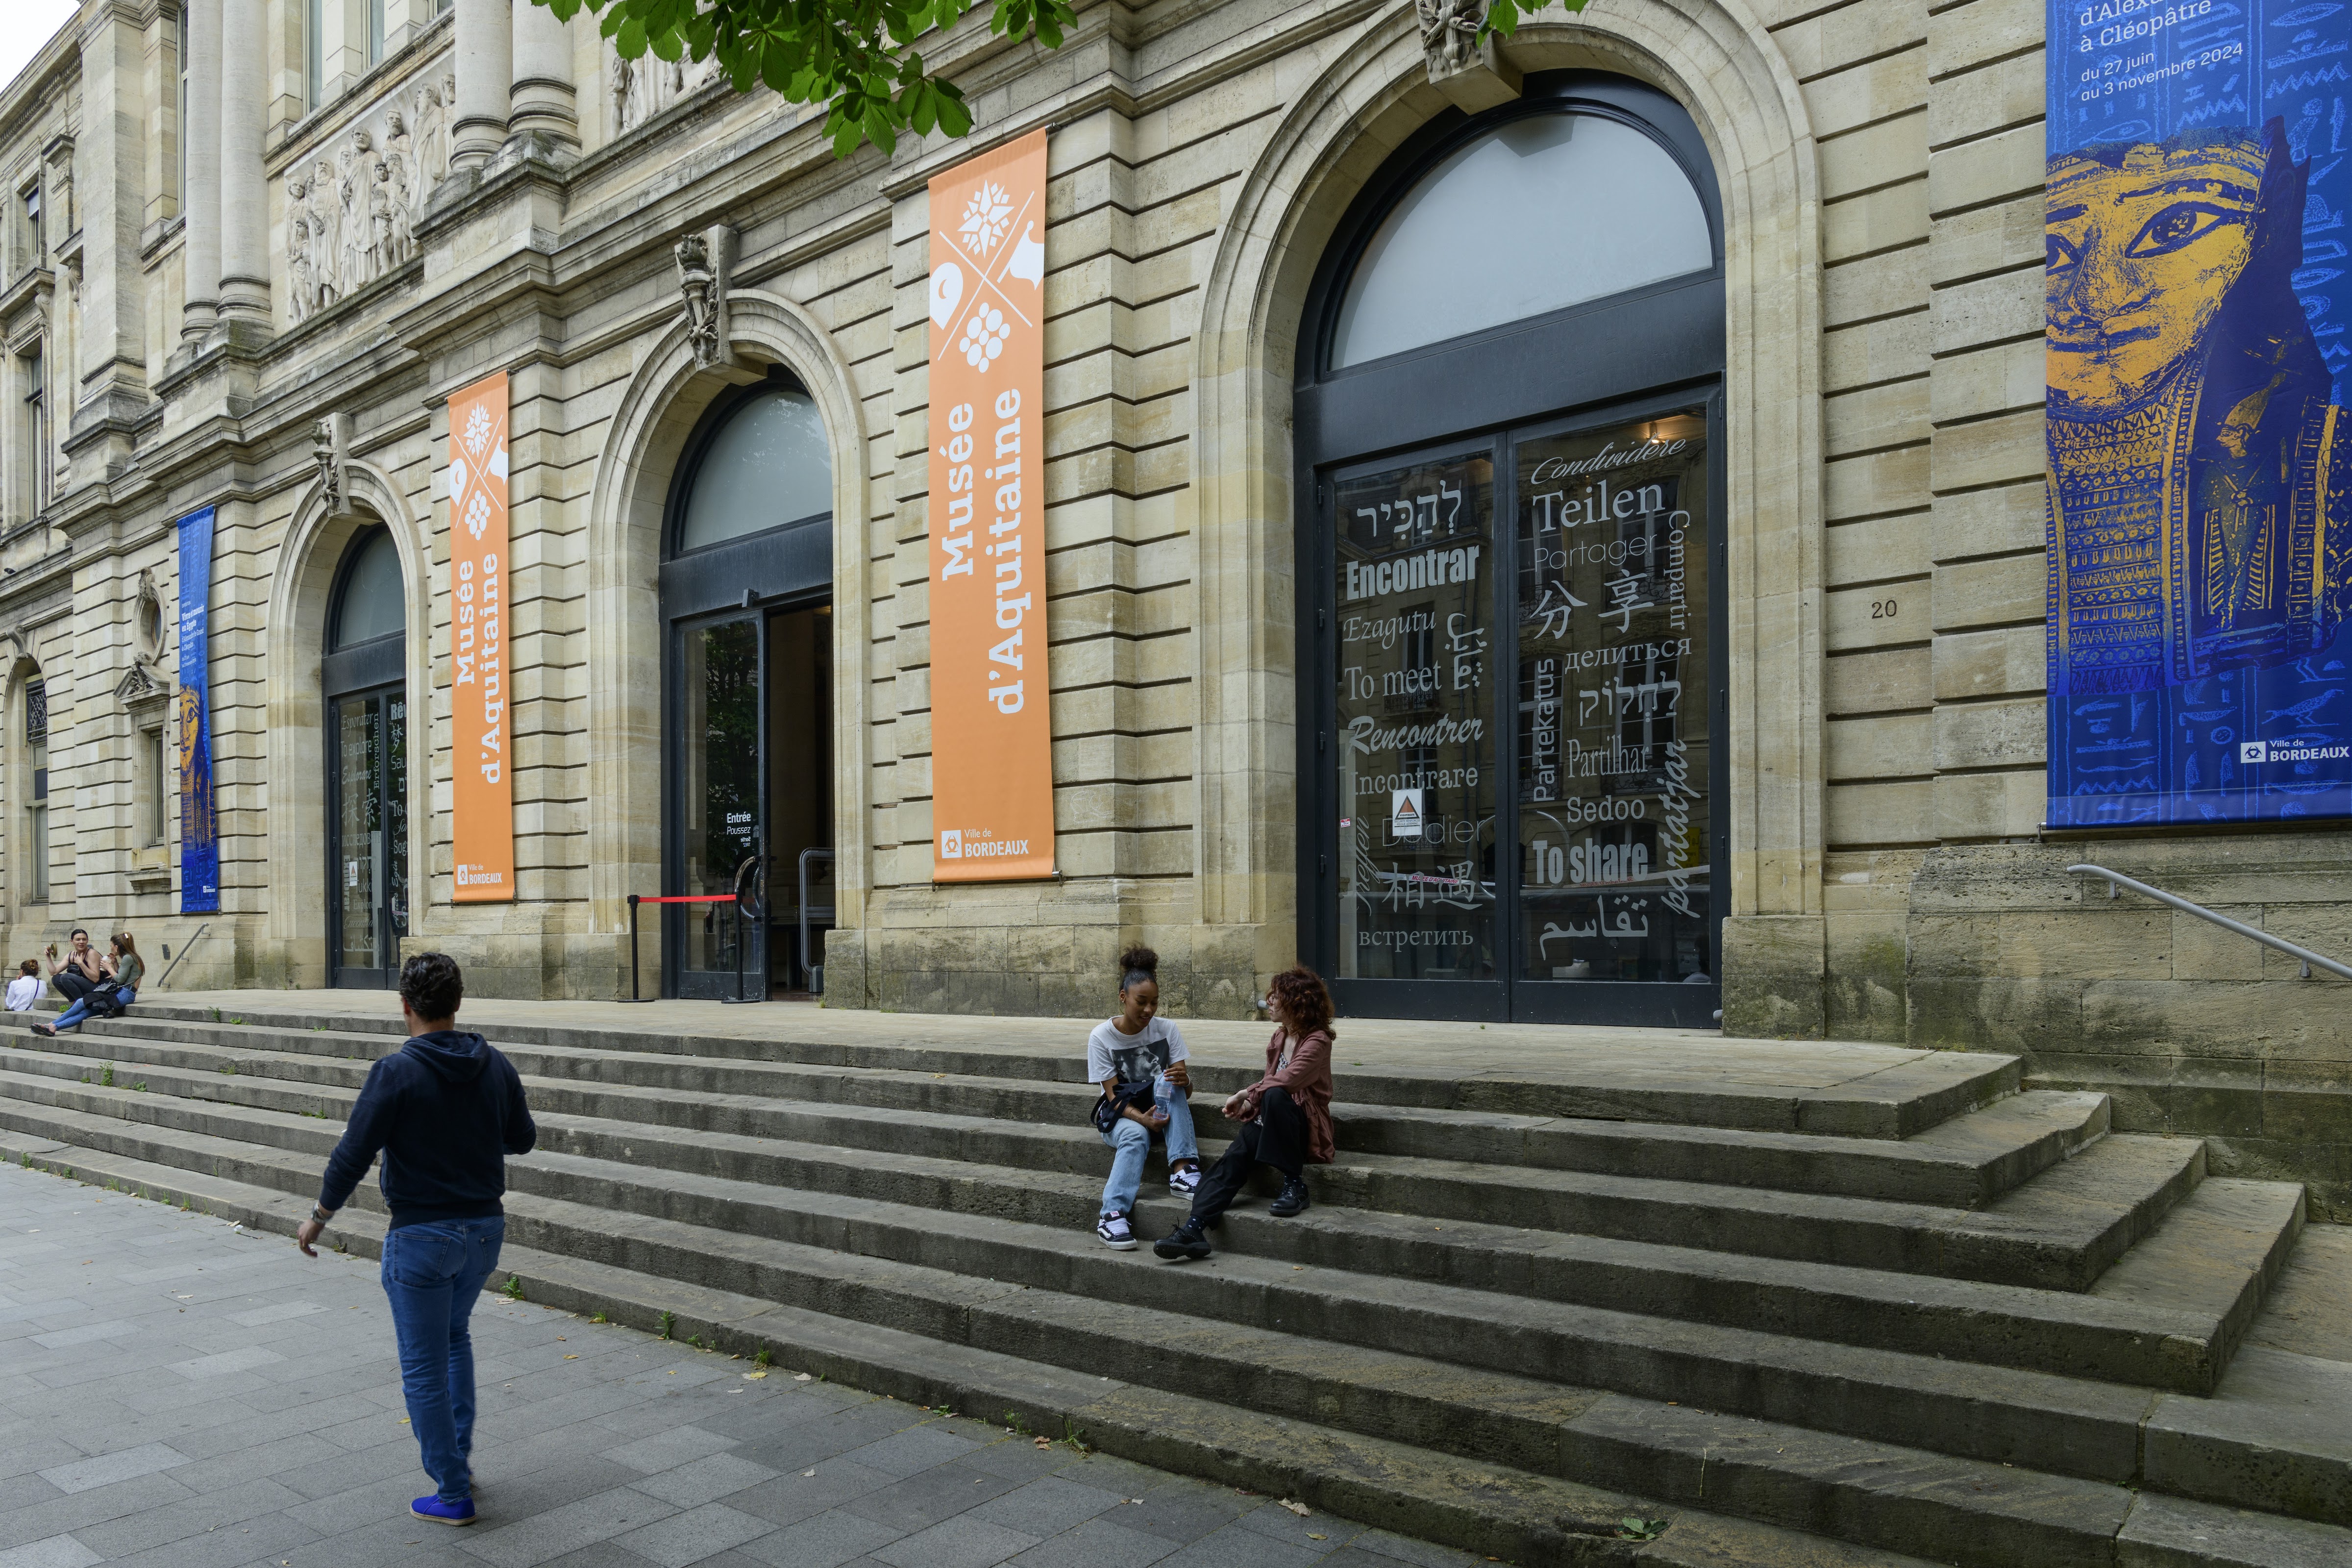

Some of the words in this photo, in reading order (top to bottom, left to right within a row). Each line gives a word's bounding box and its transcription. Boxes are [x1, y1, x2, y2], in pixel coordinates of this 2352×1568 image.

[2080, 35, 2093, 52] à
[2100, 0, 2211, 46] Cléopâtre
[2081, 69, 2100, 82] du
[2104, 60, 2123, 75] 27
[2125, 52, 2154, 73] juin
[2081, 88, 2100, 101] au
[2104, 82, 2114, 95] 3
[2119, 59, 2196, 92] novembre
[2201, 43, 2243, 66] 2024
[1531, 432, 1685, 485] Condividere
[939, 402, 973, 581] Musée
[1533, 480, 1665, 532] Teilen
[1535, 532, 1658, 572] Partager
[1663, 510, 1692, 631] Compartir
[1346, 545, 1480, 601] Encontrar
[182, 612, 191, 621] Vivre
[193, 604, 204, 616] mourir
[187, 619, 197, 632] Égypte
[456, 560, 474, 687] Musée
[1871, 599, 1897, 620] 20
[1343, 611, 1436, 650] Ezagutu
[1565, 636, 1692, 674] делиться
[1344, 666, 1374, 701] To
[1382, 660, 1442, 697] meet
[341, 741, 347, 757] To
[349, 736, 372, 761] explore
[1346, 713, 1484, 756] Rencontrer
[1532, 658, 1555, 802] Partekatus
[2270, 739, 2290, 748] Ville
[1567, 733, 1649, 778] Partilhar
[2270, 746, 2350, 762] BORDEAUX
[342, 765, 371, 787] Esplorare
[1350, 767, 1478, 796] Incontrare
[342, 788, 377, 828] 探索
[392, 800, 403, 817] To
[727, 811, 751, 823] Entrée
[1567, 795, 1645, 823] Sedoo
[726, 826, 751, 835] Poussez
[964, 829, 980, 838] Ville
[983, 828, 991, 837] de
[965, 840, 1029, 857] BORDEAUX
[1657, 739, 1702, 919] partatjar
[469, 872, 502, 885] BORDEAUX
[1533, 840, 1563, 884] To
[1570, 838, 1648, 883] share
[1381, 860, 1483, 913] 相遇
[1359, 930, 1474, 952] встретить
[1539, 895, 1648, 961] تقاسم
